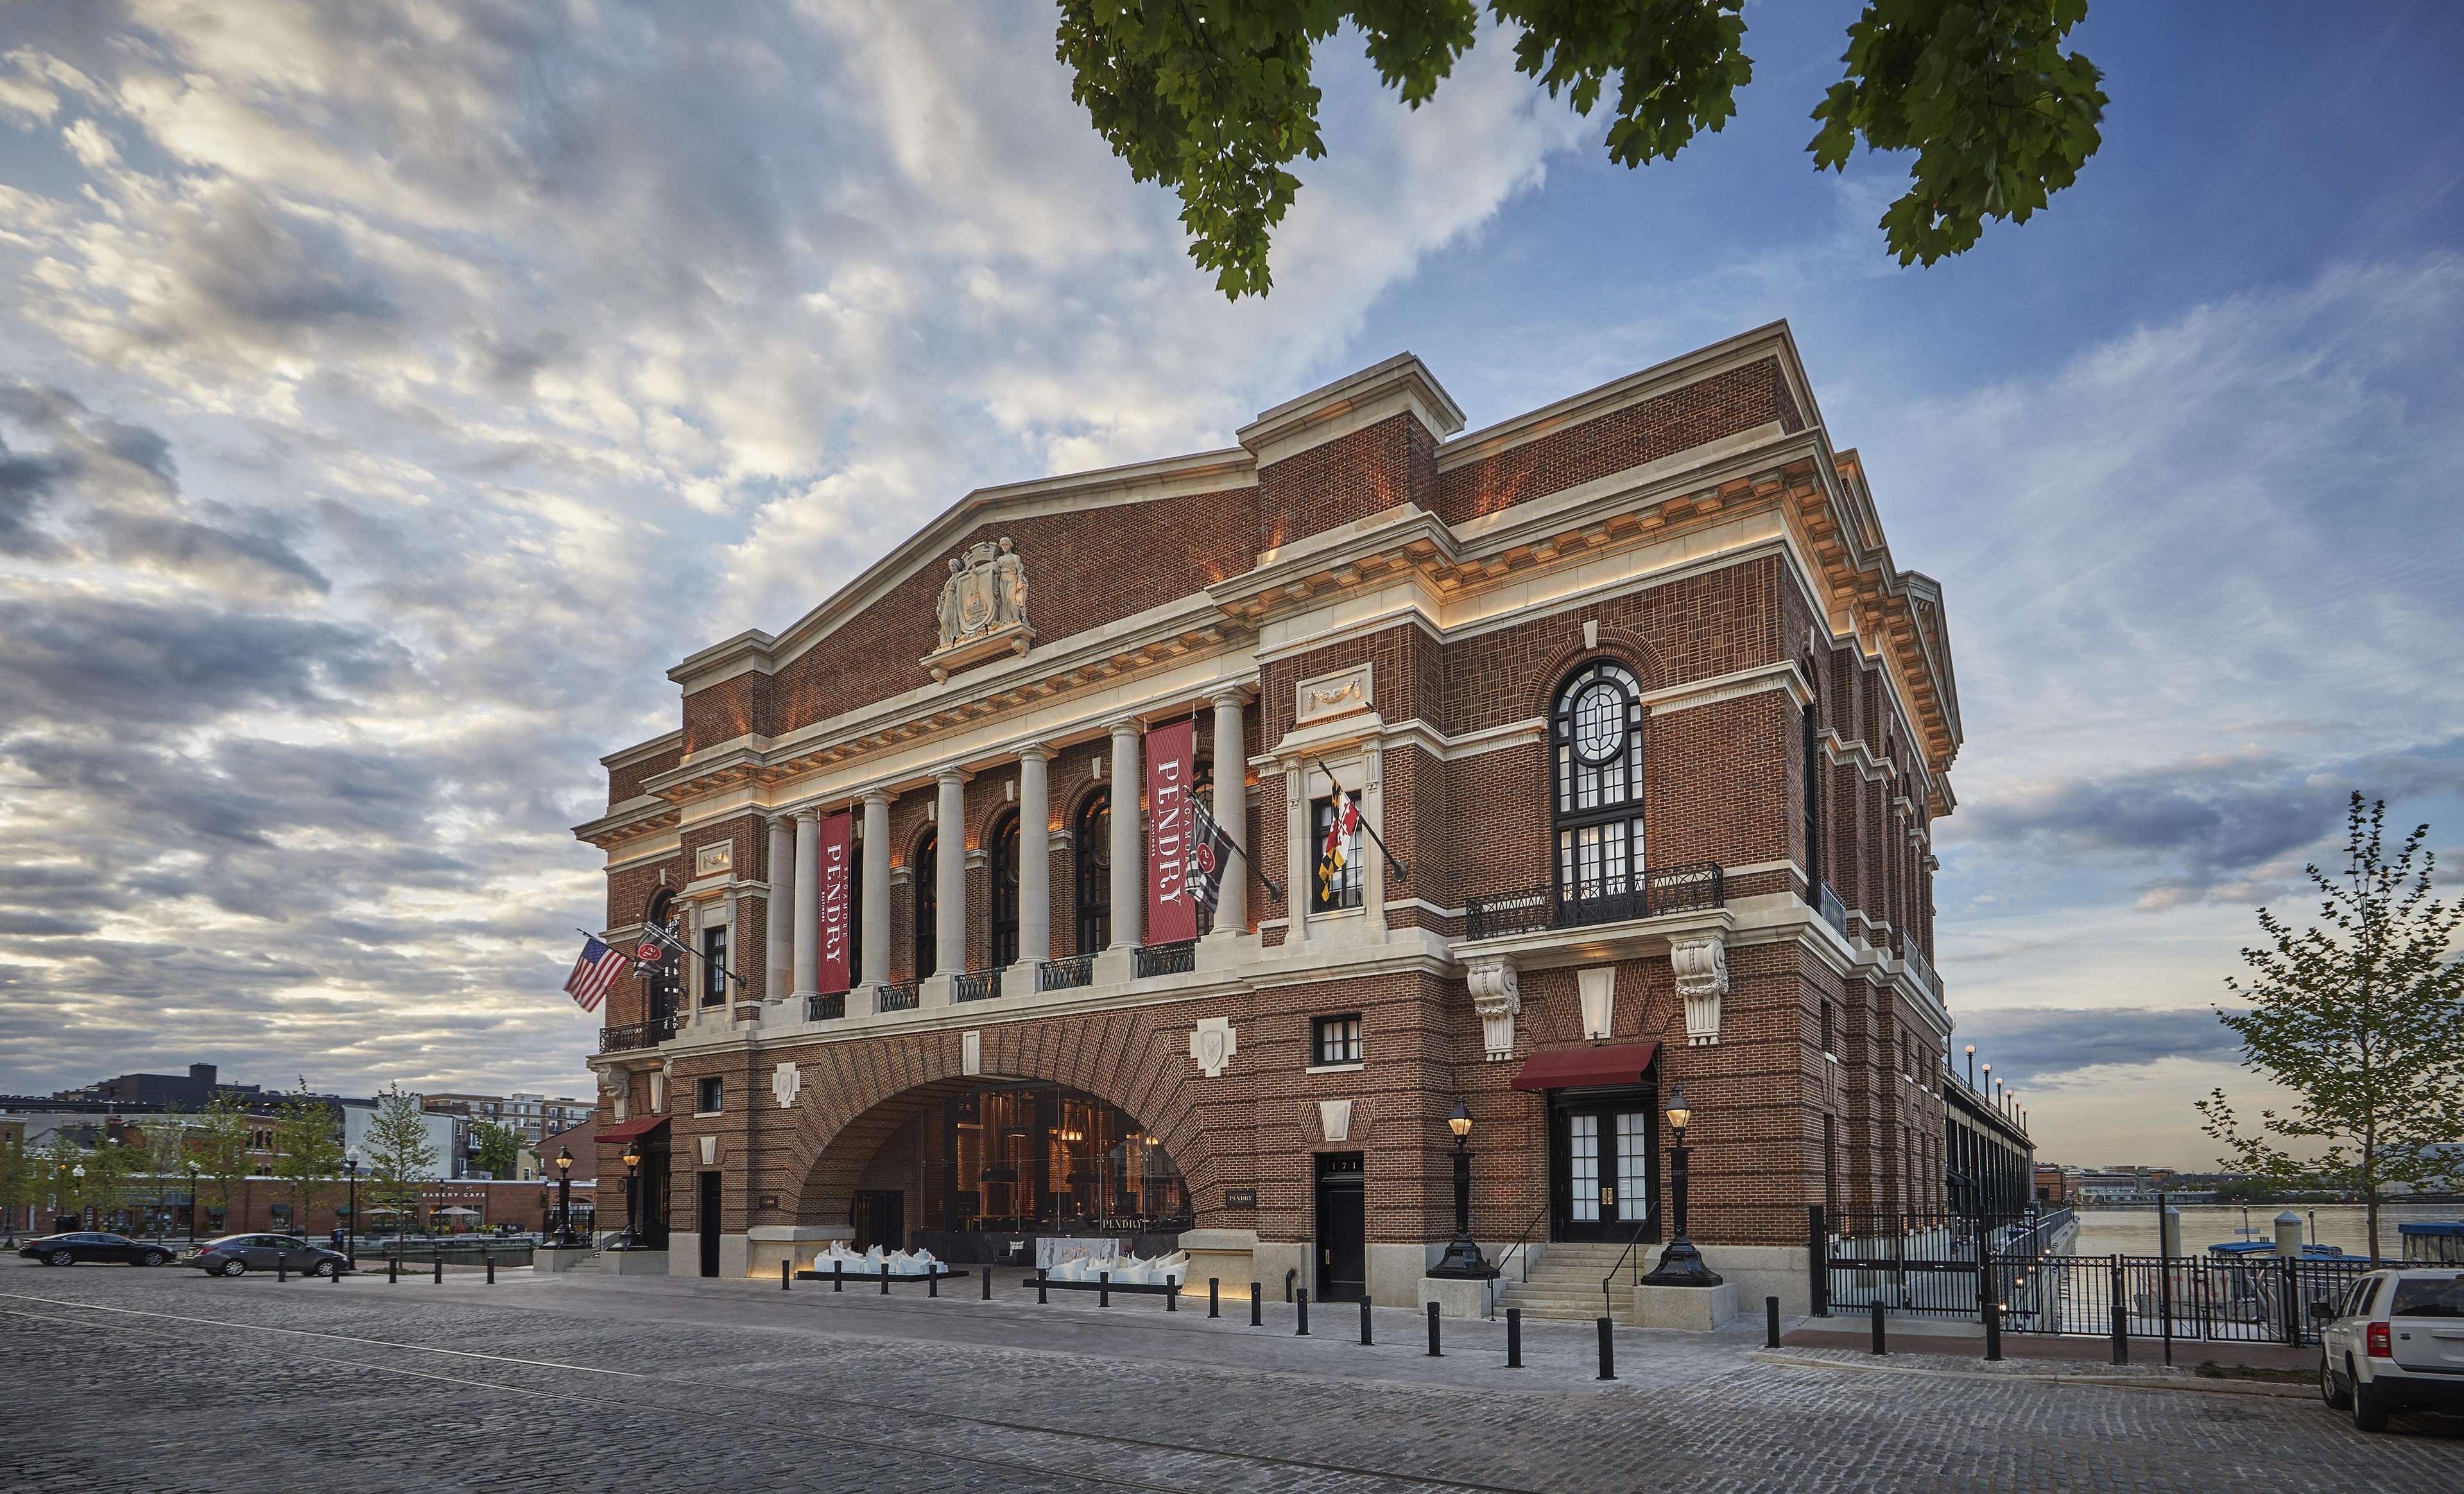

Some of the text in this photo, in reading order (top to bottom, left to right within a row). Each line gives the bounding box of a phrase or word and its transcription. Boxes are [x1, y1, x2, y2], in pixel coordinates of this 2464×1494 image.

[1158, 758, 1182, 906] PENDRY
[826, 843, 841, 964] PENDRY
[1103, 1219, 1141, 1228] PENDRY
